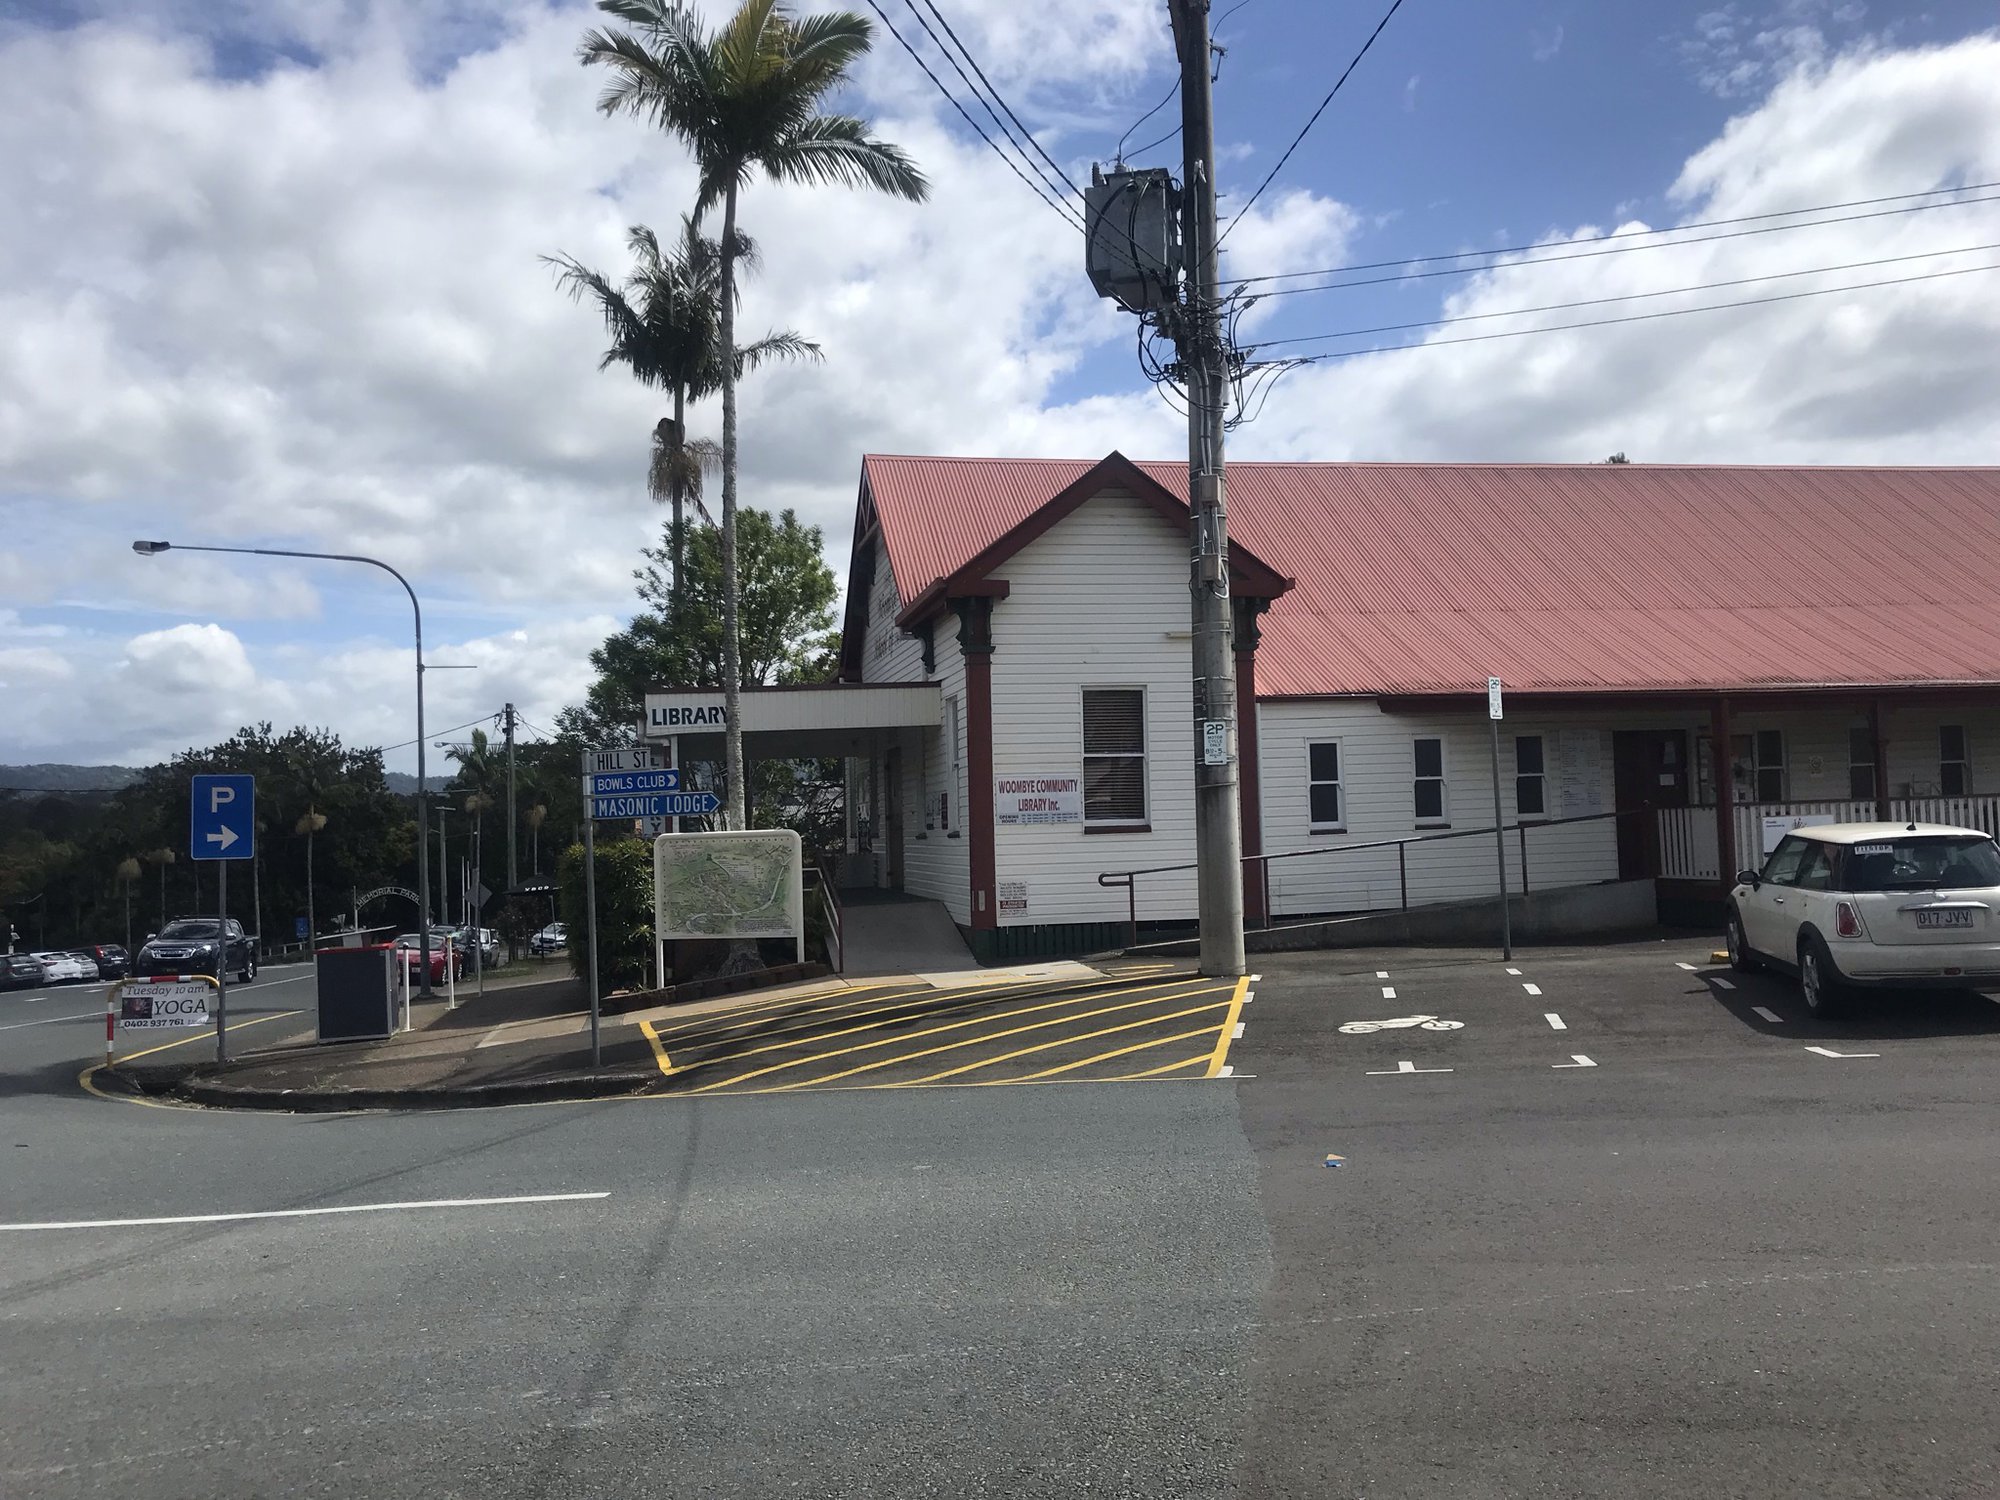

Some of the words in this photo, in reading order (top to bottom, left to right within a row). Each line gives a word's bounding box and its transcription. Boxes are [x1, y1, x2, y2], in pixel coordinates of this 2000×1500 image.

[652, 706, 727, 726] LIBRARY
[1206, 724, 1224, 734] 2P
[597, 752, 624, 770] HILL
[633, 751, 648, 769] ST
[597, 777, 634, 791] BOWLS
[636, 775, 666, 789] CLUB
[998, 780, 1035, 794] WOOMBYE
[1036, 779, 1079, 793] COMMUNITY
[211, 786, 236, 813] P
[598, 797, 659, 817] MASONIC
[666, 794, 710, 814] LODGE
[1018, 798, 1047, 812] LIBRARY
[1048, 798, 1060, 812] Inc.
[356, 887, 395, 906] MEMORIAL
[400, 888, 420, 905] PARK
[1918, 912, 1940, 924] 017
[1945, 911, 1969, 923] JVV
[127, 985, 172, 997] Tuesday
[176, 986, 186, 994] 10
[187, 985, 205, 994] am
[154, 999, 207, 1016] YOGA
[124, 1020, 149, 1028] 0402
[150, 1019, 168, 1028] 937
[169, 1018, 185, 1027] 761
